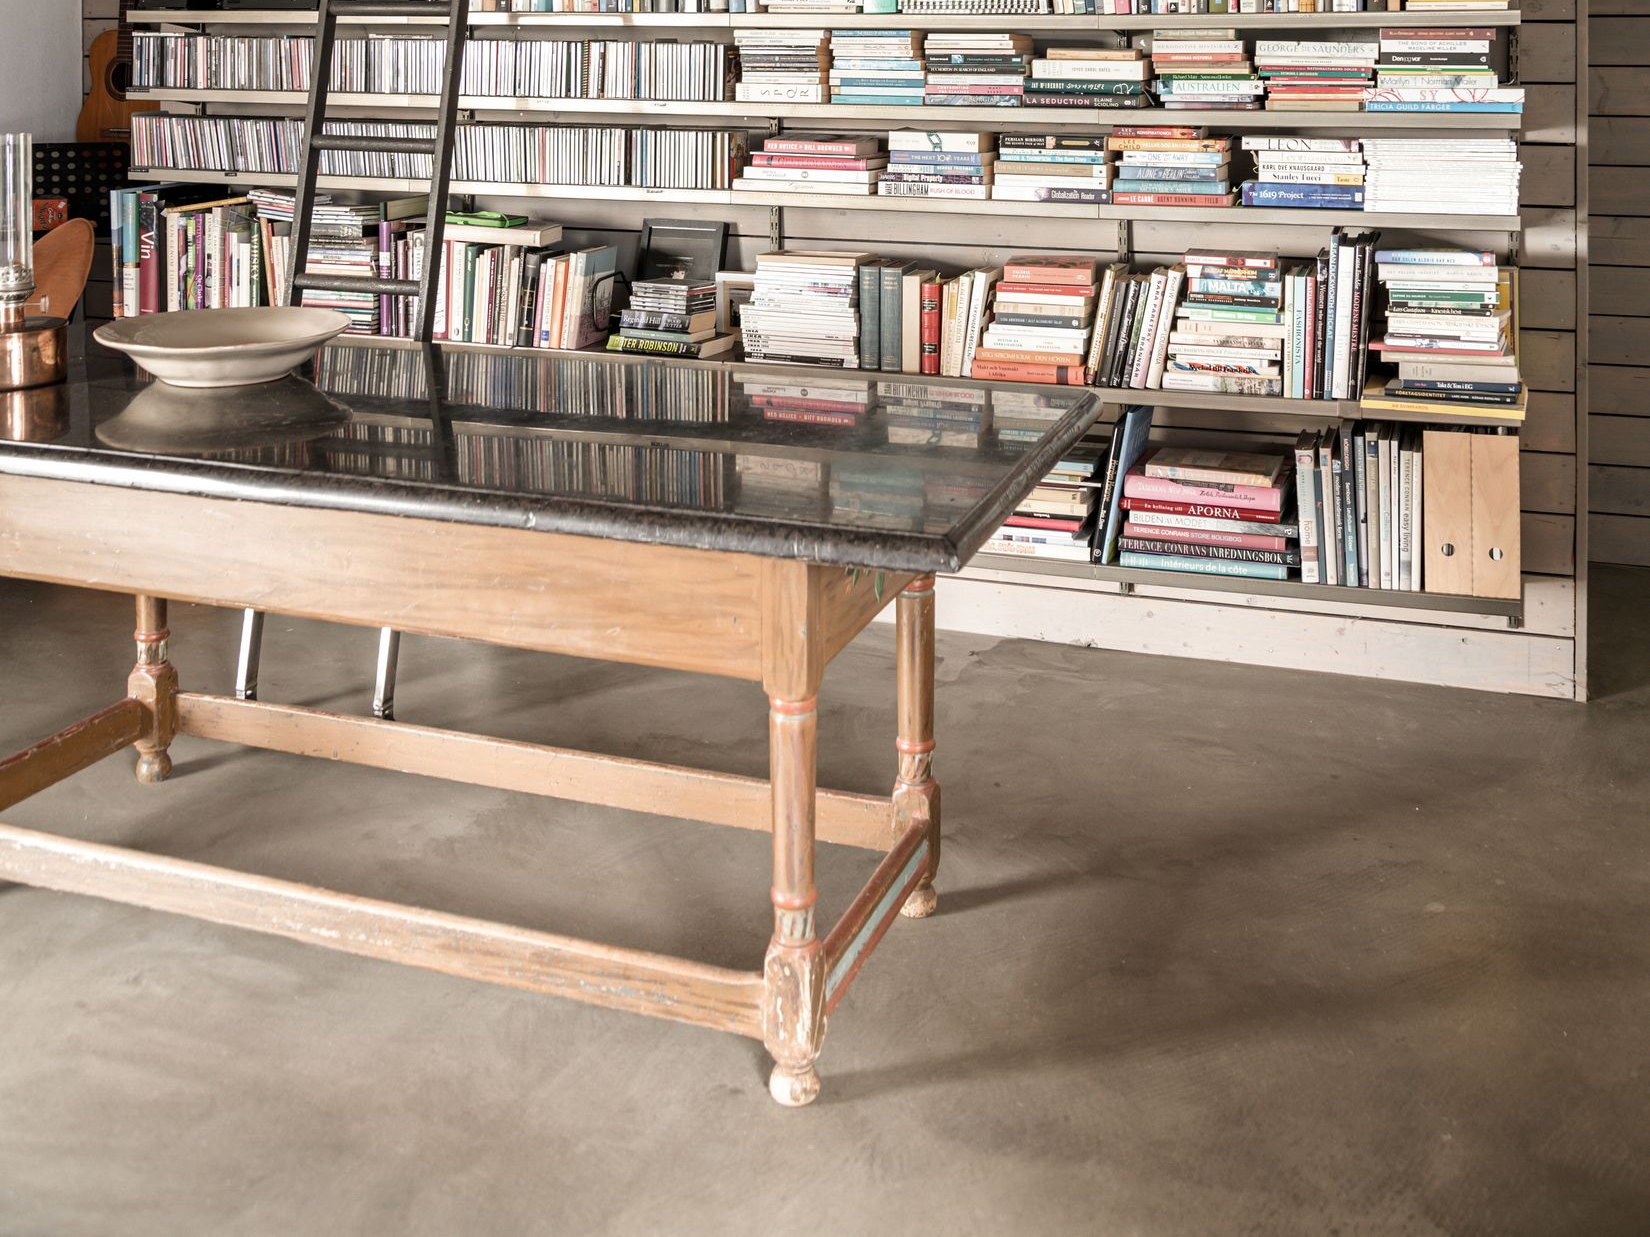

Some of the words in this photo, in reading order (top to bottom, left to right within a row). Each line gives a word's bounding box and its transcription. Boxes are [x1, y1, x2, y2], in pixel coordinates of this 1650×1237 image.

[1176, 83, 1240, 91] AUSTRALIEN
[894, 183, 929, 195] BILLINGHAM
[1051, 190, 1080, 199] Globalization
[1081, 192, 1095, 200] Reader
[1259, 191, 1277, 199] 1619
[1137, 194, 1154, 202] CARRÉ
[140, 231, 155, 259] Vin
[251, 233, 260, 281] WHISKY
[1154, 280, 1163, 301] SARA
[1209, 282, 1246, 291] MALTA
[1328, 265, 1337, 308] DUCKWORTH
[1145, 303, 1159, 343] PARETSKY
[640, 338, 680, 352] ROBINSON
[1395, 389, 1446, 398] FÖRETAGSIDENTITET
[1133, 513, 1158, 523] BILDEN
[1154, 503, 1173, 512] hyllning
[1188, 504, 1240, 520] APORNA
[1401, 513, 1411, 530] easy
[1133, 526, 1158, 534] TERENCE
[1159, 527, 1190, 537] CONRANS
[1211, 533, 1242, 543] BOLIGBOG
[1303, 520, 1313, 545] home
[1401, 532, 1412, 552] living
[1123, 538, 1163, 553] TERENCE
[1164, 541, 1207, 556] CONRANS
[1209, 546, 1283, 564] INREDNINGSBOK
[1160, 559, 1203, 571] Intérieurs
[1206, 561, 1216, 572] de
[1218, 563, 1226, 572] la
[1227, 564, 1248, 576] côte
